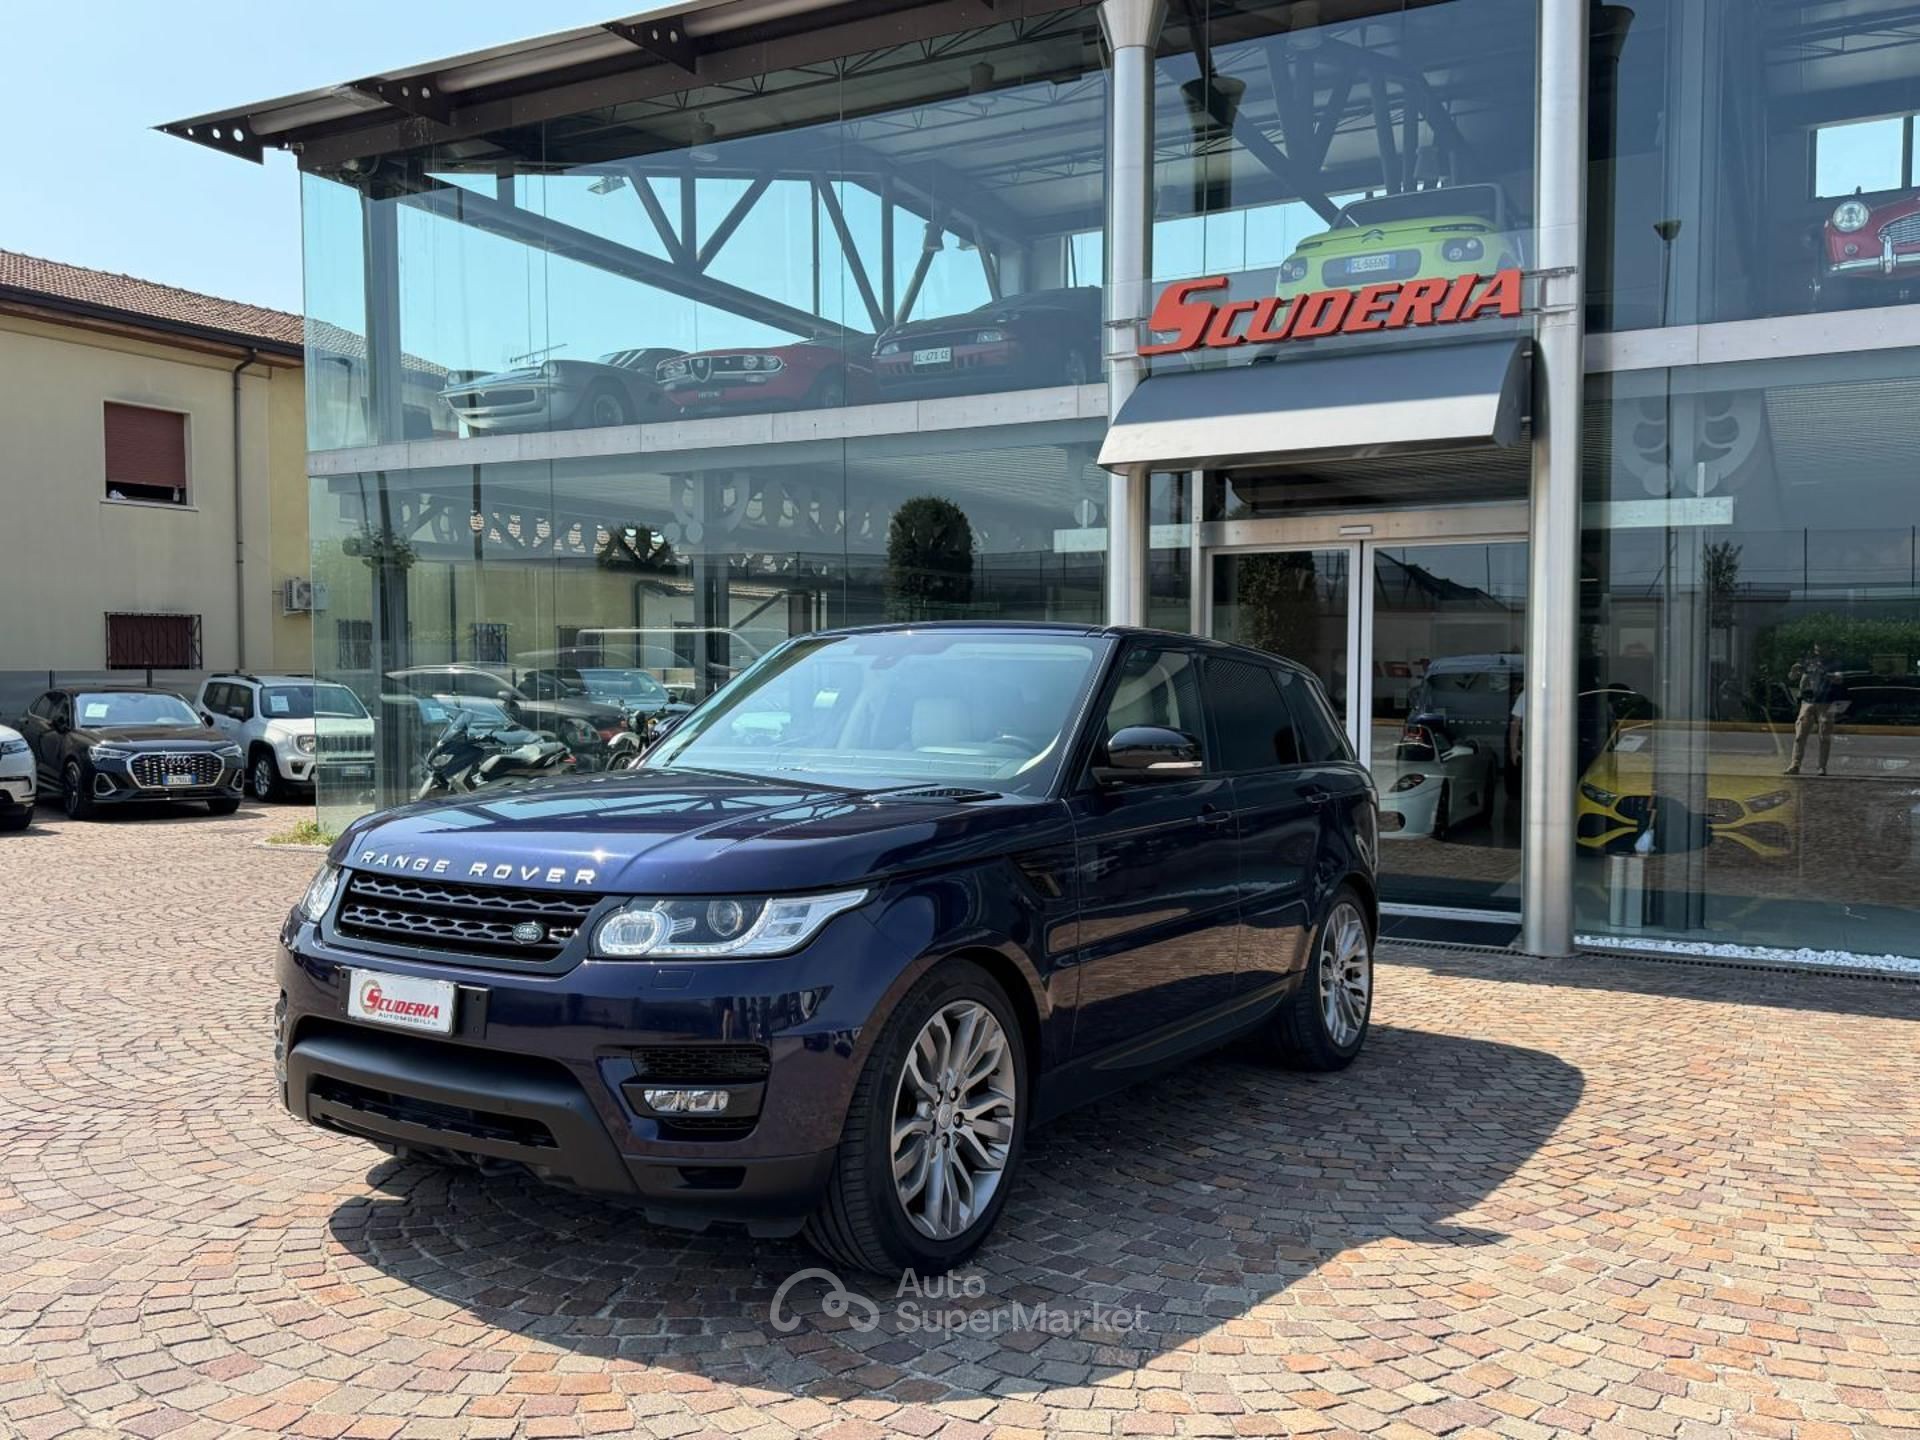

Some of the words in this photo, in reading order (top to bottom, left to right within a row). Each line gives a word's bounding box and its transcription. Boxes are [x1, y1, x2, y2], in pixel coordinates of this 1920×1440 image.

[1136, 268, 1523, 356] SCUDERIA
[360, 850, 450, 873] RANGE
[468, 861, 597, 885] ROVER
[364, 989, 440, 1019] SCUDERIA
[378, 1012, 431, 1026] AUTOMOBILI
